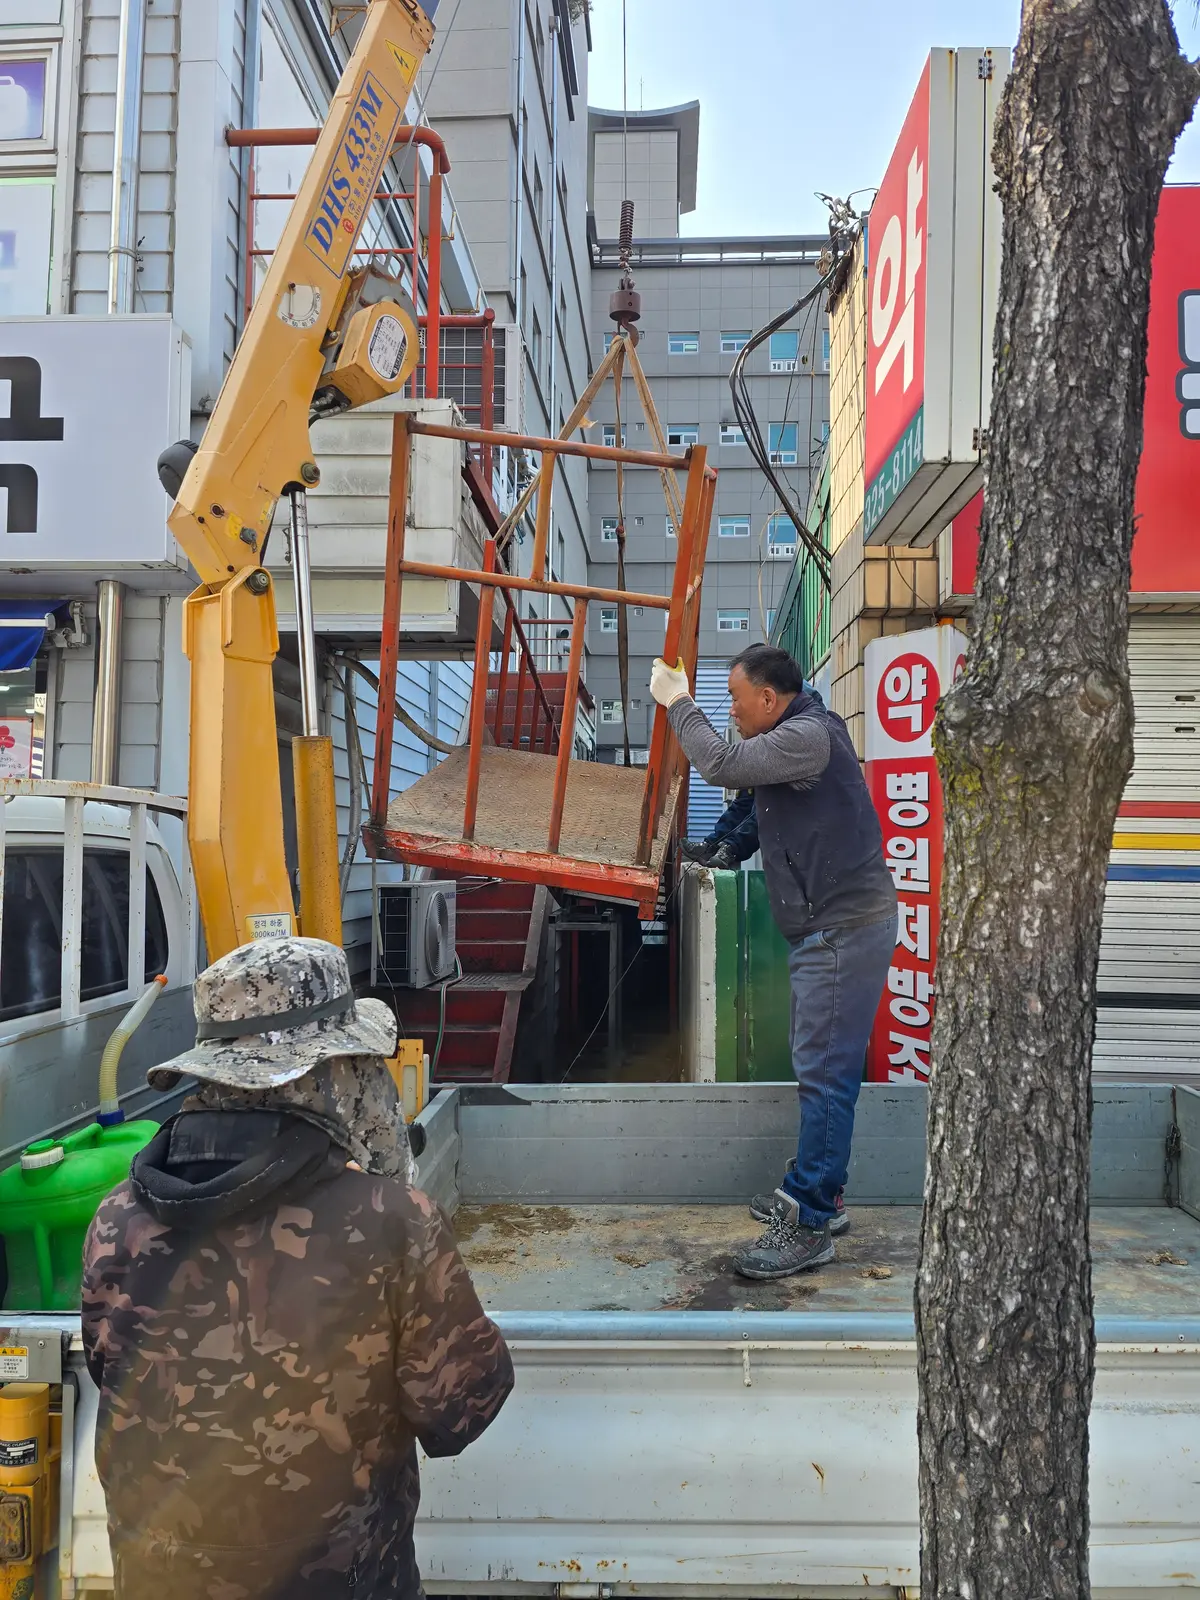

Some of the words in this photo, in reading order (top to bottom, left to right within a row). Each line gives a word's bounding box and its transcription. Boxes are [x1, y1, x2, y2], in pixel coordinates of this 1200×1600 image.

[311, 167, 351, 256] DHS
[345, 81, 383, 173] 433M
[872, 143, 923, 396] 약
[865, 416, 921, 533] 325-8114
[884, 664, 927, 732] 약
[254, 920, 266, 929] 정격
[270, 919, 282, 927] 하중
